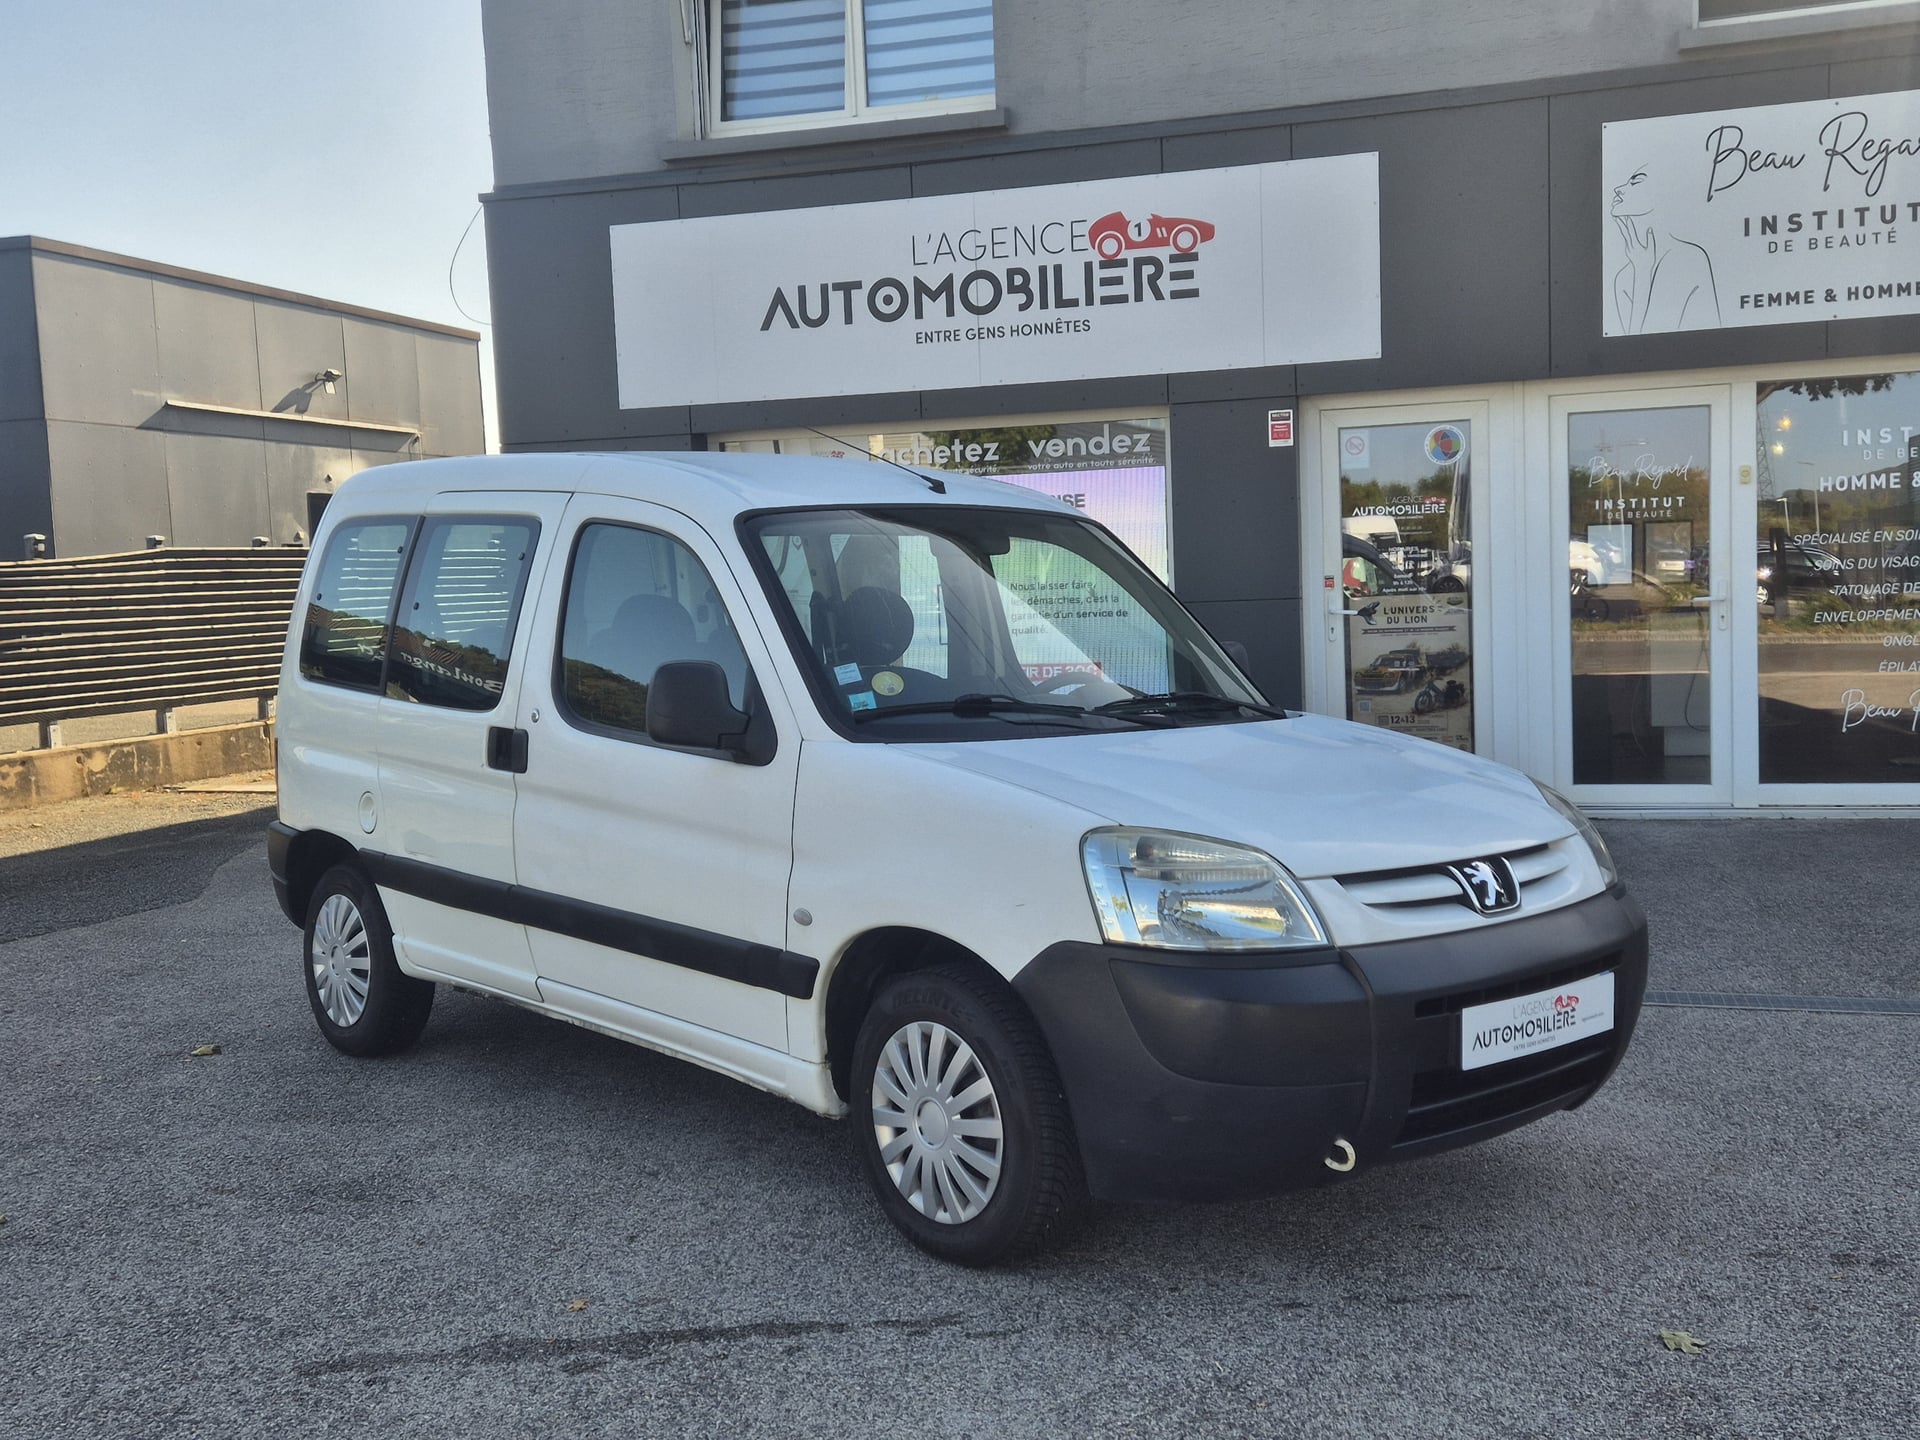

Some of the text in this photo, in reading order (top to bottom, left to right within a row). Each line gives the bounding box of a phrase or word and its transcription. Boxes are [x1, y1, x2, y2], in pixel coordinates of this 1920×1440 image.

[1706, 125, 1805, 202] Beau
[1743, 202, 1920, 237] INSTITUT
[1134, 222, 1142, 238] 1
[912, 219, 1089, 266] L'AGENCE
[1768, 227, 1897, 253] DE BEAUTÉ
[1740, 289, 1815, 309] FEMME
[1824, 288, 1838, 302] &
[915, 317, 1091, 345] ENTRE GENS HONNÊTES
[1027, 423, 1151, 459] vendez
[1843, 426, 1913, 446] INST
[878, 434, 1000, 466] achetez
[1863, 446, 1919, 461] DE BE
[1027, 460, 1051, 471] votre
[1053, 460, 1075, 470] auto
[1077, 460, 1089, 468] en
[1091, 458, 1114, 468] toute
[1588, 453, 1694, 489] Beau Regard
[1819, 472, 1902, 492] HOMME
[1385, 495, 1424, 505] L'AGENCE
[1595, 496, 1686, 511] INSTITUT
[1607, 509, 1673, 520] DE BEAUTÉ
[1793, 528, 1920, 546] SPÉCIALISÉ EN SOI
[1813, 555, 1920, 572] SOINS DU VISAG
[1010, 582, 1037, 592] Nous
[1833, 582, 1900, 596] TATOUAGE
[1027, 595, 1083, 607] démarches,
[1086, 594, 1109, 604] c'est
[1111, 594, 1119, 604] la
[1076, 609, 1114, 619] service
[1116, 608, 1128, 618] de
[1386, 615, 1428, 624] DU LION
[1841, 688, 1902, 733] Beau
[1512, 996, 1555, 1020] L'AGENCE
